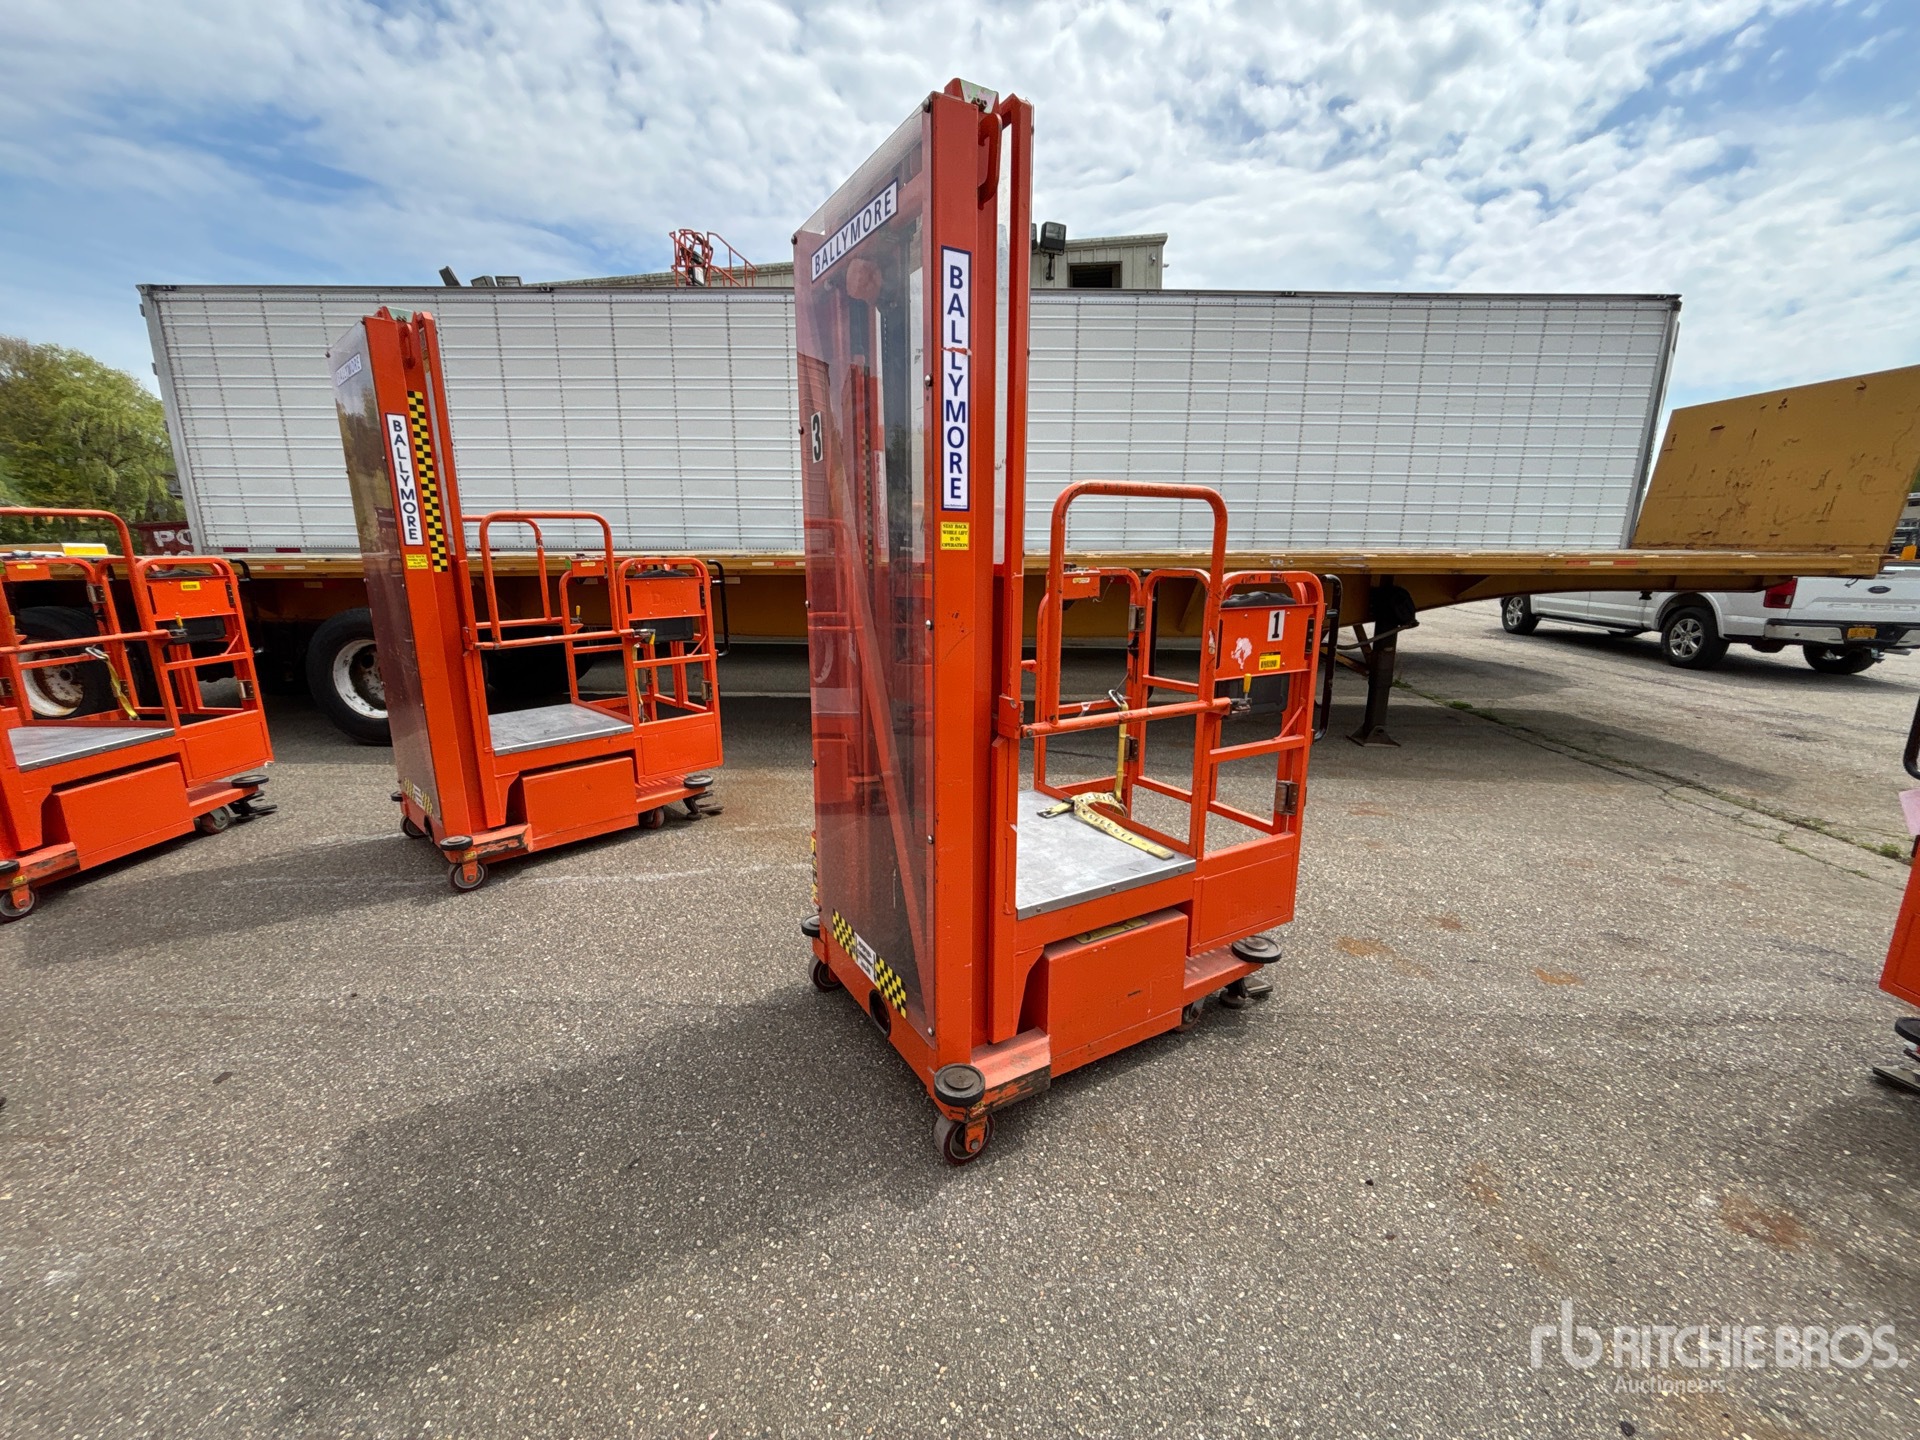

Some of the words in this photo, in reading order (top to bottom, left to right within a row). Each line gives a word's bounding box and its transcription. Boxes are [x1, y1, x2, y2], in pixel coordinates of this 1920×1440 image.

[814, 189, 892, 275] BALLYMORE
[945, 265, 966, 499] BALLYMORE
[392, 420, 418, 540] BALLYMORE
[813, 414, 821, 461] 3
[1272, 612, 1280, 638] 1
